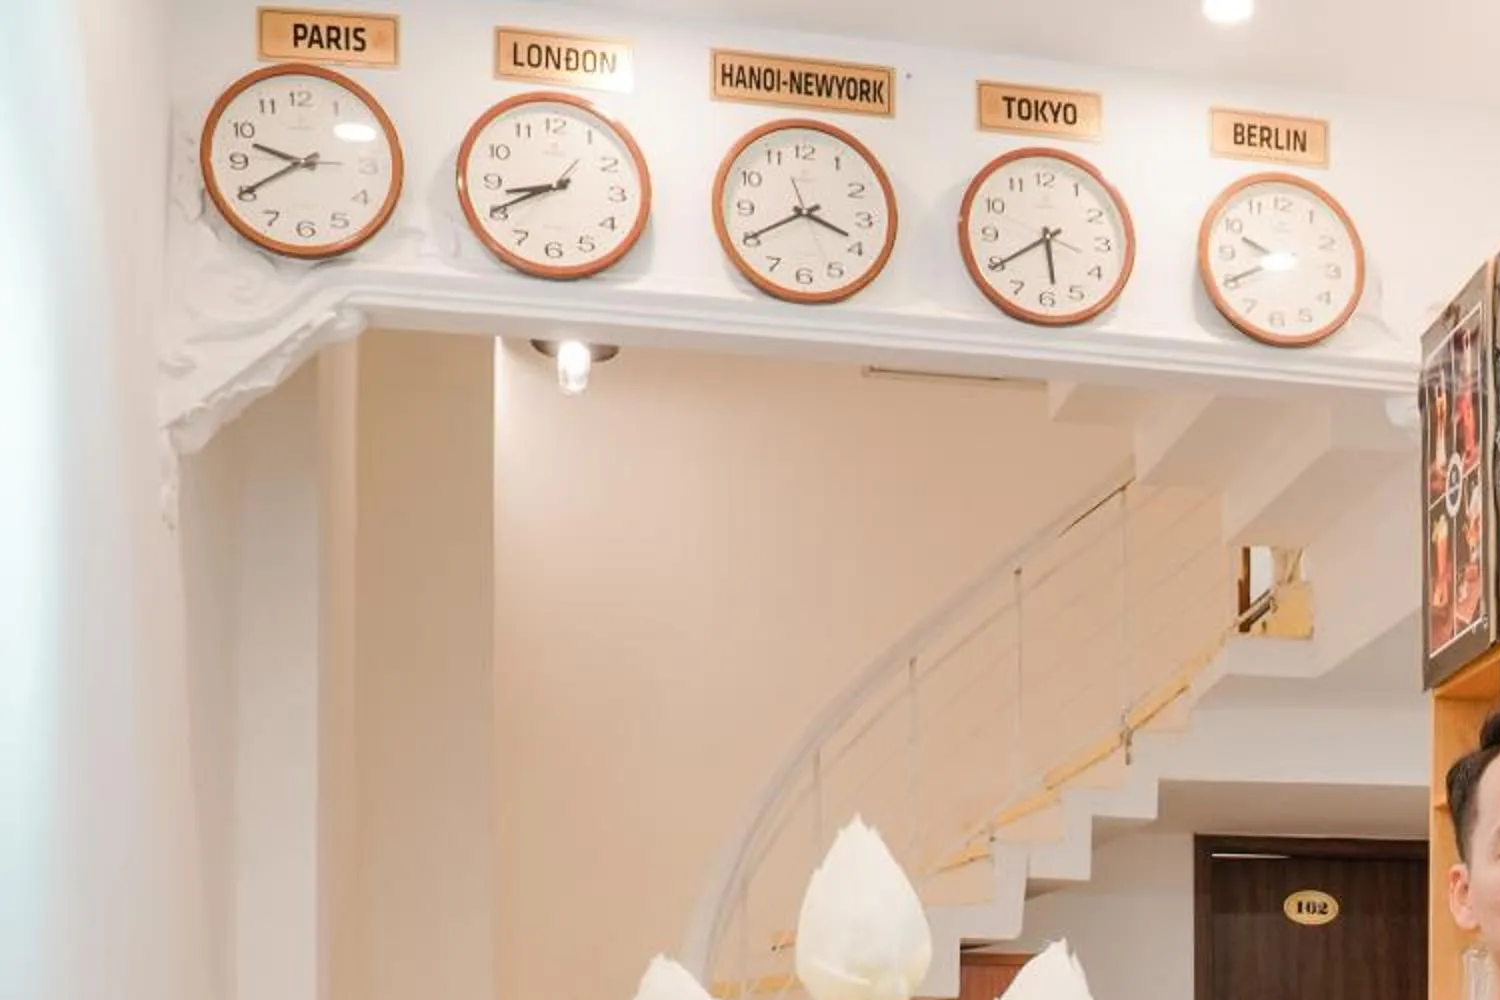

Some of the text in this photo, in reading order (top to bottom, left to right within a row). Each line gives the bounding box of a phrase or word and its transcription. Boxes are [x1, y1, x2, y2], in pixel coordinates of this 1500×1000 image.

[293, 23, 367, 51] PARIS
[721, 63, 885, 104] HANOI-NEWYORK
[259, 99, 275, 114] 11
[290, 91, 313, 107] 12
[1002, 95, 1077, 125] TOKYO
[233, 122, 255, 138] 10
[516, 122, 531, 138] 11
[546, 118, 566, 133] 12
[586, 129, 593, 144] 1
[1233, 122, 1307, 152] BERLIN
[489, 144, 510, 160] 10
[767, 150, 782, 165] 11
[795, 145, 816, 160] 12
[230, 153, 248, 170] 9
[359, 159, 378, 175] 3
[600, 156, 618, 172] 2
[833, 156, 841, 171] 1
[484, 173, 502, 190] 9
[742, 171, 762, 187] 10
[1009, 178, 1023, 192] 11
[1035, 172, 1055, 187] 12
[352, 190, 368, 205] 4
[609, 185, 627, 202] 3
[848, 183, 865, 198] 2
[1073, 183, 1080, 196] 1
[737, 200, 755, 216] 9
[986, 197, 1004, 214] 10
[1249, 200, 1261, 215] 11
[1274, 196, 1293, 212] 12
[264, 210, 279, 226] 7
[331, 212, 349, 228] 5
[599, 217, 615, 231] 4
[855, 211, 873, 228] 3
[1087, 209, 1103, 223] 2
[296, 221, 316, 237] 6
[1225, 217, 1243, 233] 10
[513, 230, 528, 246] 7
[982, 226, 998, 242] 9
[545, 241, 563, 258] 6
[578, 235, 595, 252] 5
[847, 241, 863, 256] 4
[1095, 237, 1110, 252] 3
[1319, 235, 1336, 250] 2
[1219, 245, 1235, 261] 9
[766, 255, 781, 272] 7
[827, 261, 844, 278] 5
[1325, 264, 1342, 279] 3
[796, 268, 813, 285] 6
[1088, 265, 1102, 280] 4
[1010, 279, 1024, 295] 7
[1068, 285, 1084, 300] 5
[1039, 291, 1056, 307] 6
[1243, 297, 1258, 314] 7
[1317, 291, 1331, 304] 4
[1268, 311, 1285, 327] 6
[1299, 308, 1312, 322] 5
[1297, 901, 1328, 914] 102
